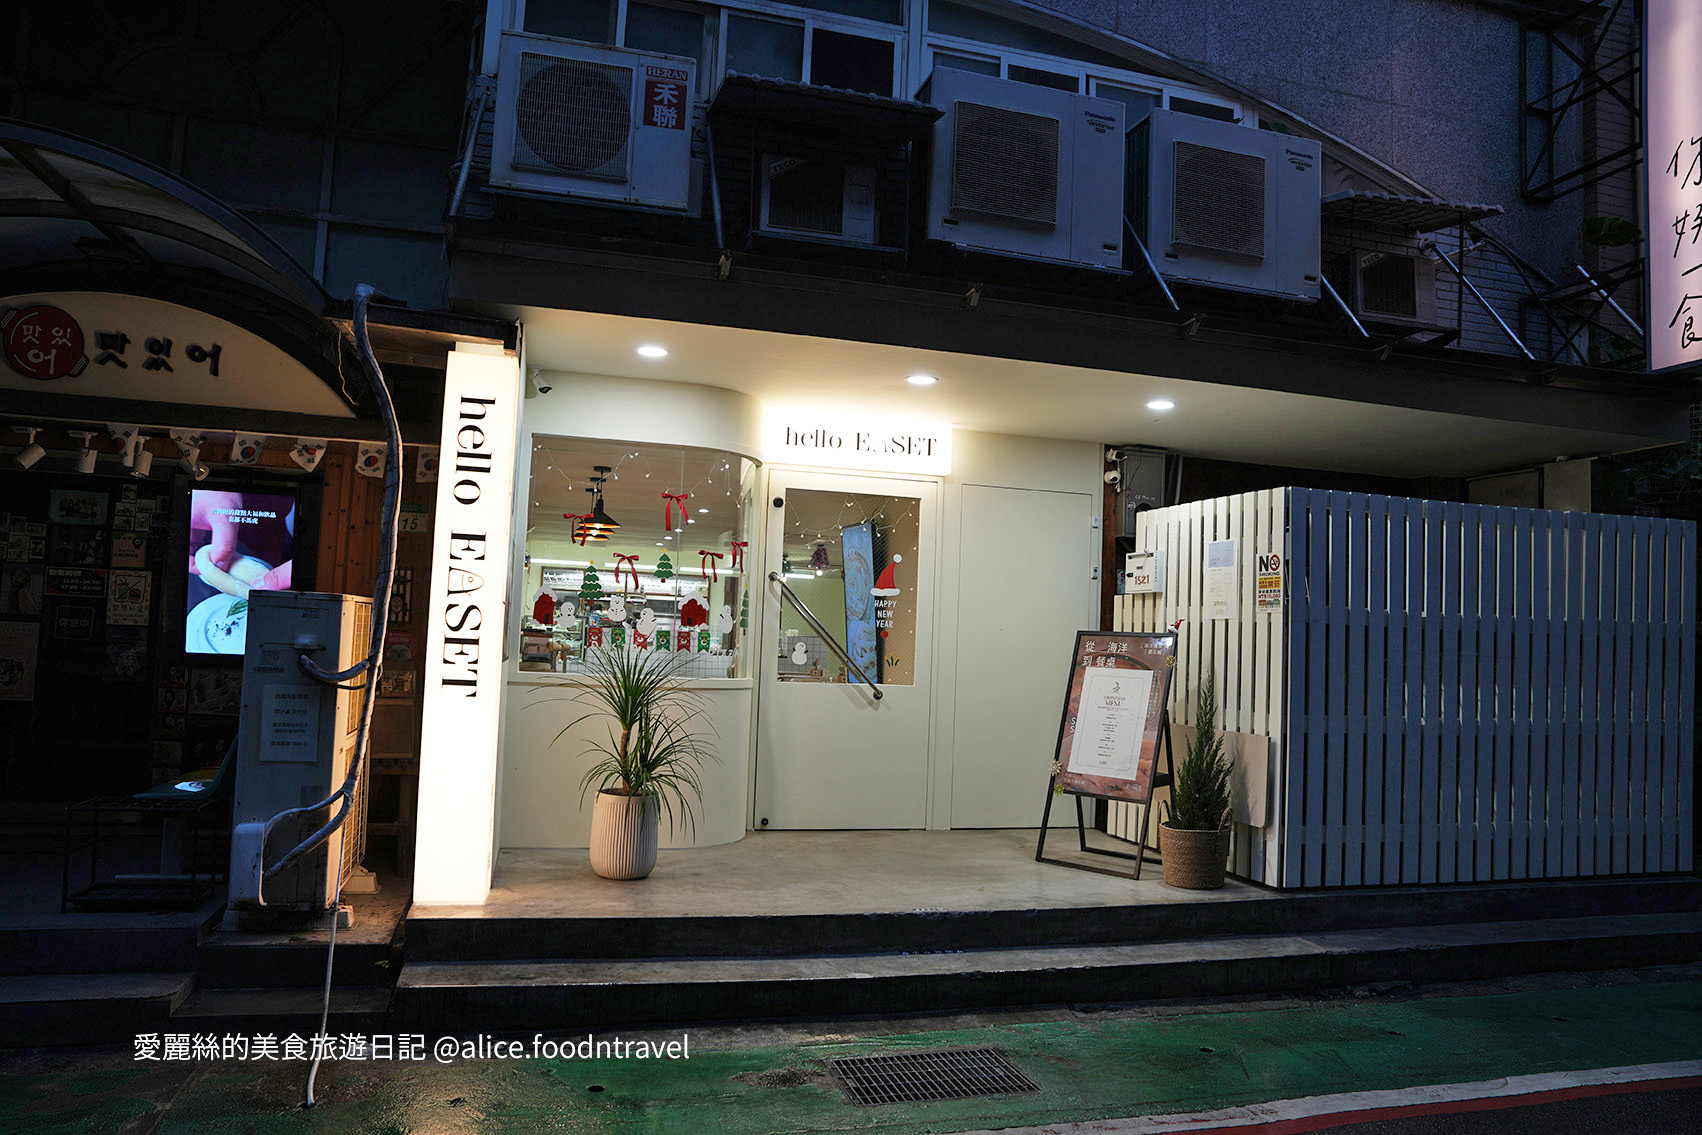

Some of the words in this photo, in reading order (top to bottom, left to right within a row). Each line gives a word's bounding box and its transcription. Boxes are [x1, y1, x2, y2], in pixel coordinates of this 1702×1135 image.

[647, 67, 687, 81] HERAN
[653, 84, 679, 128] 禾聯
[1084, 111, 1115, 122] Panasonic
[1286, 148, 1314, 160] Panasonic
[785, 426, 843, 450] hello
[856, 432, 937, 457] EASET
[453, 394, 497, 505] hello
[1134, 574, 1150, 585] 1521
[874, 599, 898, 609] HAPPY
[441, 529, 487, 698] EASET
[877, 609, 894, 618] NEW
[875, 619, 894, 629] YEAR
[1085, 640, 1096, 653] 從
[1107, 641, 1128, 654] 海洋
